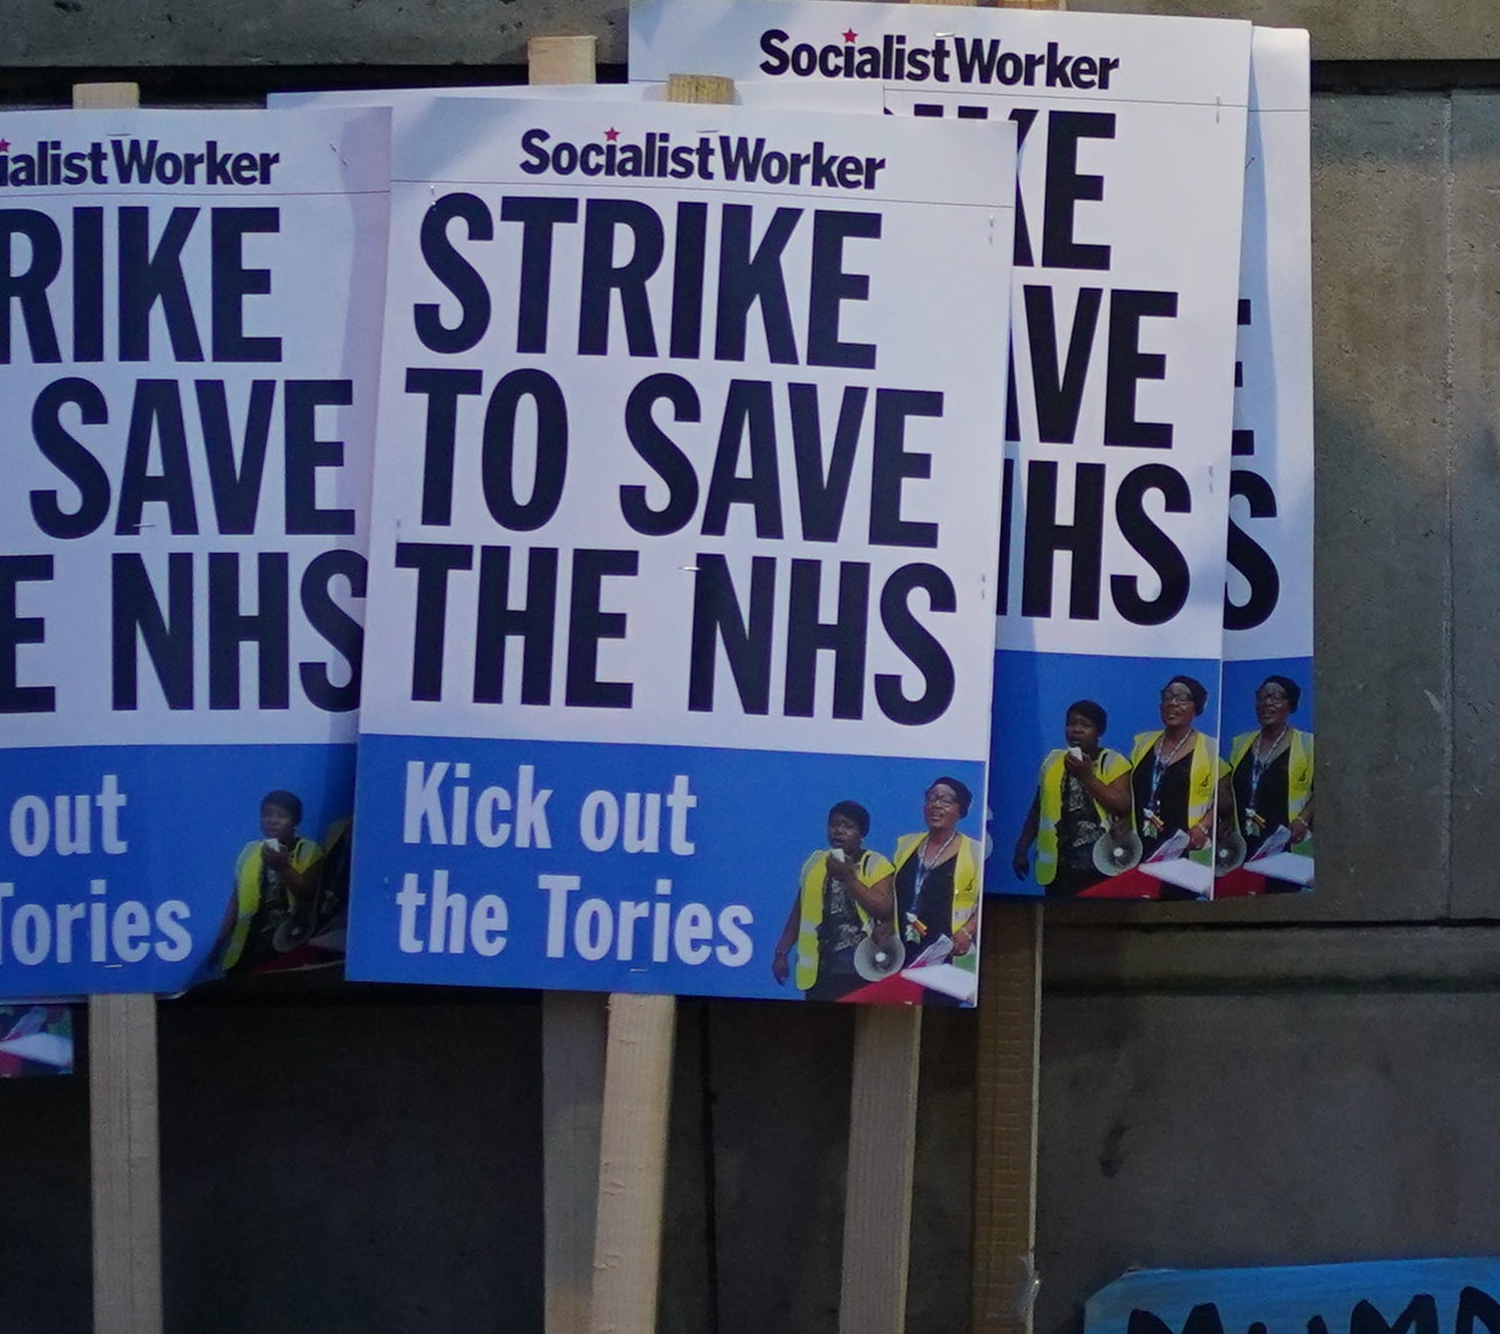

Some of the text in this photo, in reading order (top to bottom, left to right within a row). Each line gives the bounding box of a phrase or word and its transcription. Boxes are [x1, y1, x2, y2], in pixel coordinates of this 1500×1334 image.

[110, 139, 280, 185] Worker
[519, 127, 886, 190] Socialist Worker
[413, 192, 882, 370] STRIKE
[29, 377, 355, 539] SAVE
[404, 367, 945, 548] TO SAVE
[112, 549, 369, 713] NHS
[395, 542, 957, 726] THE NHS
[10, 775, 128, 855] out
[403, 761, 697, 856] Kick out
[397, 870, 754, 967] the Tories
